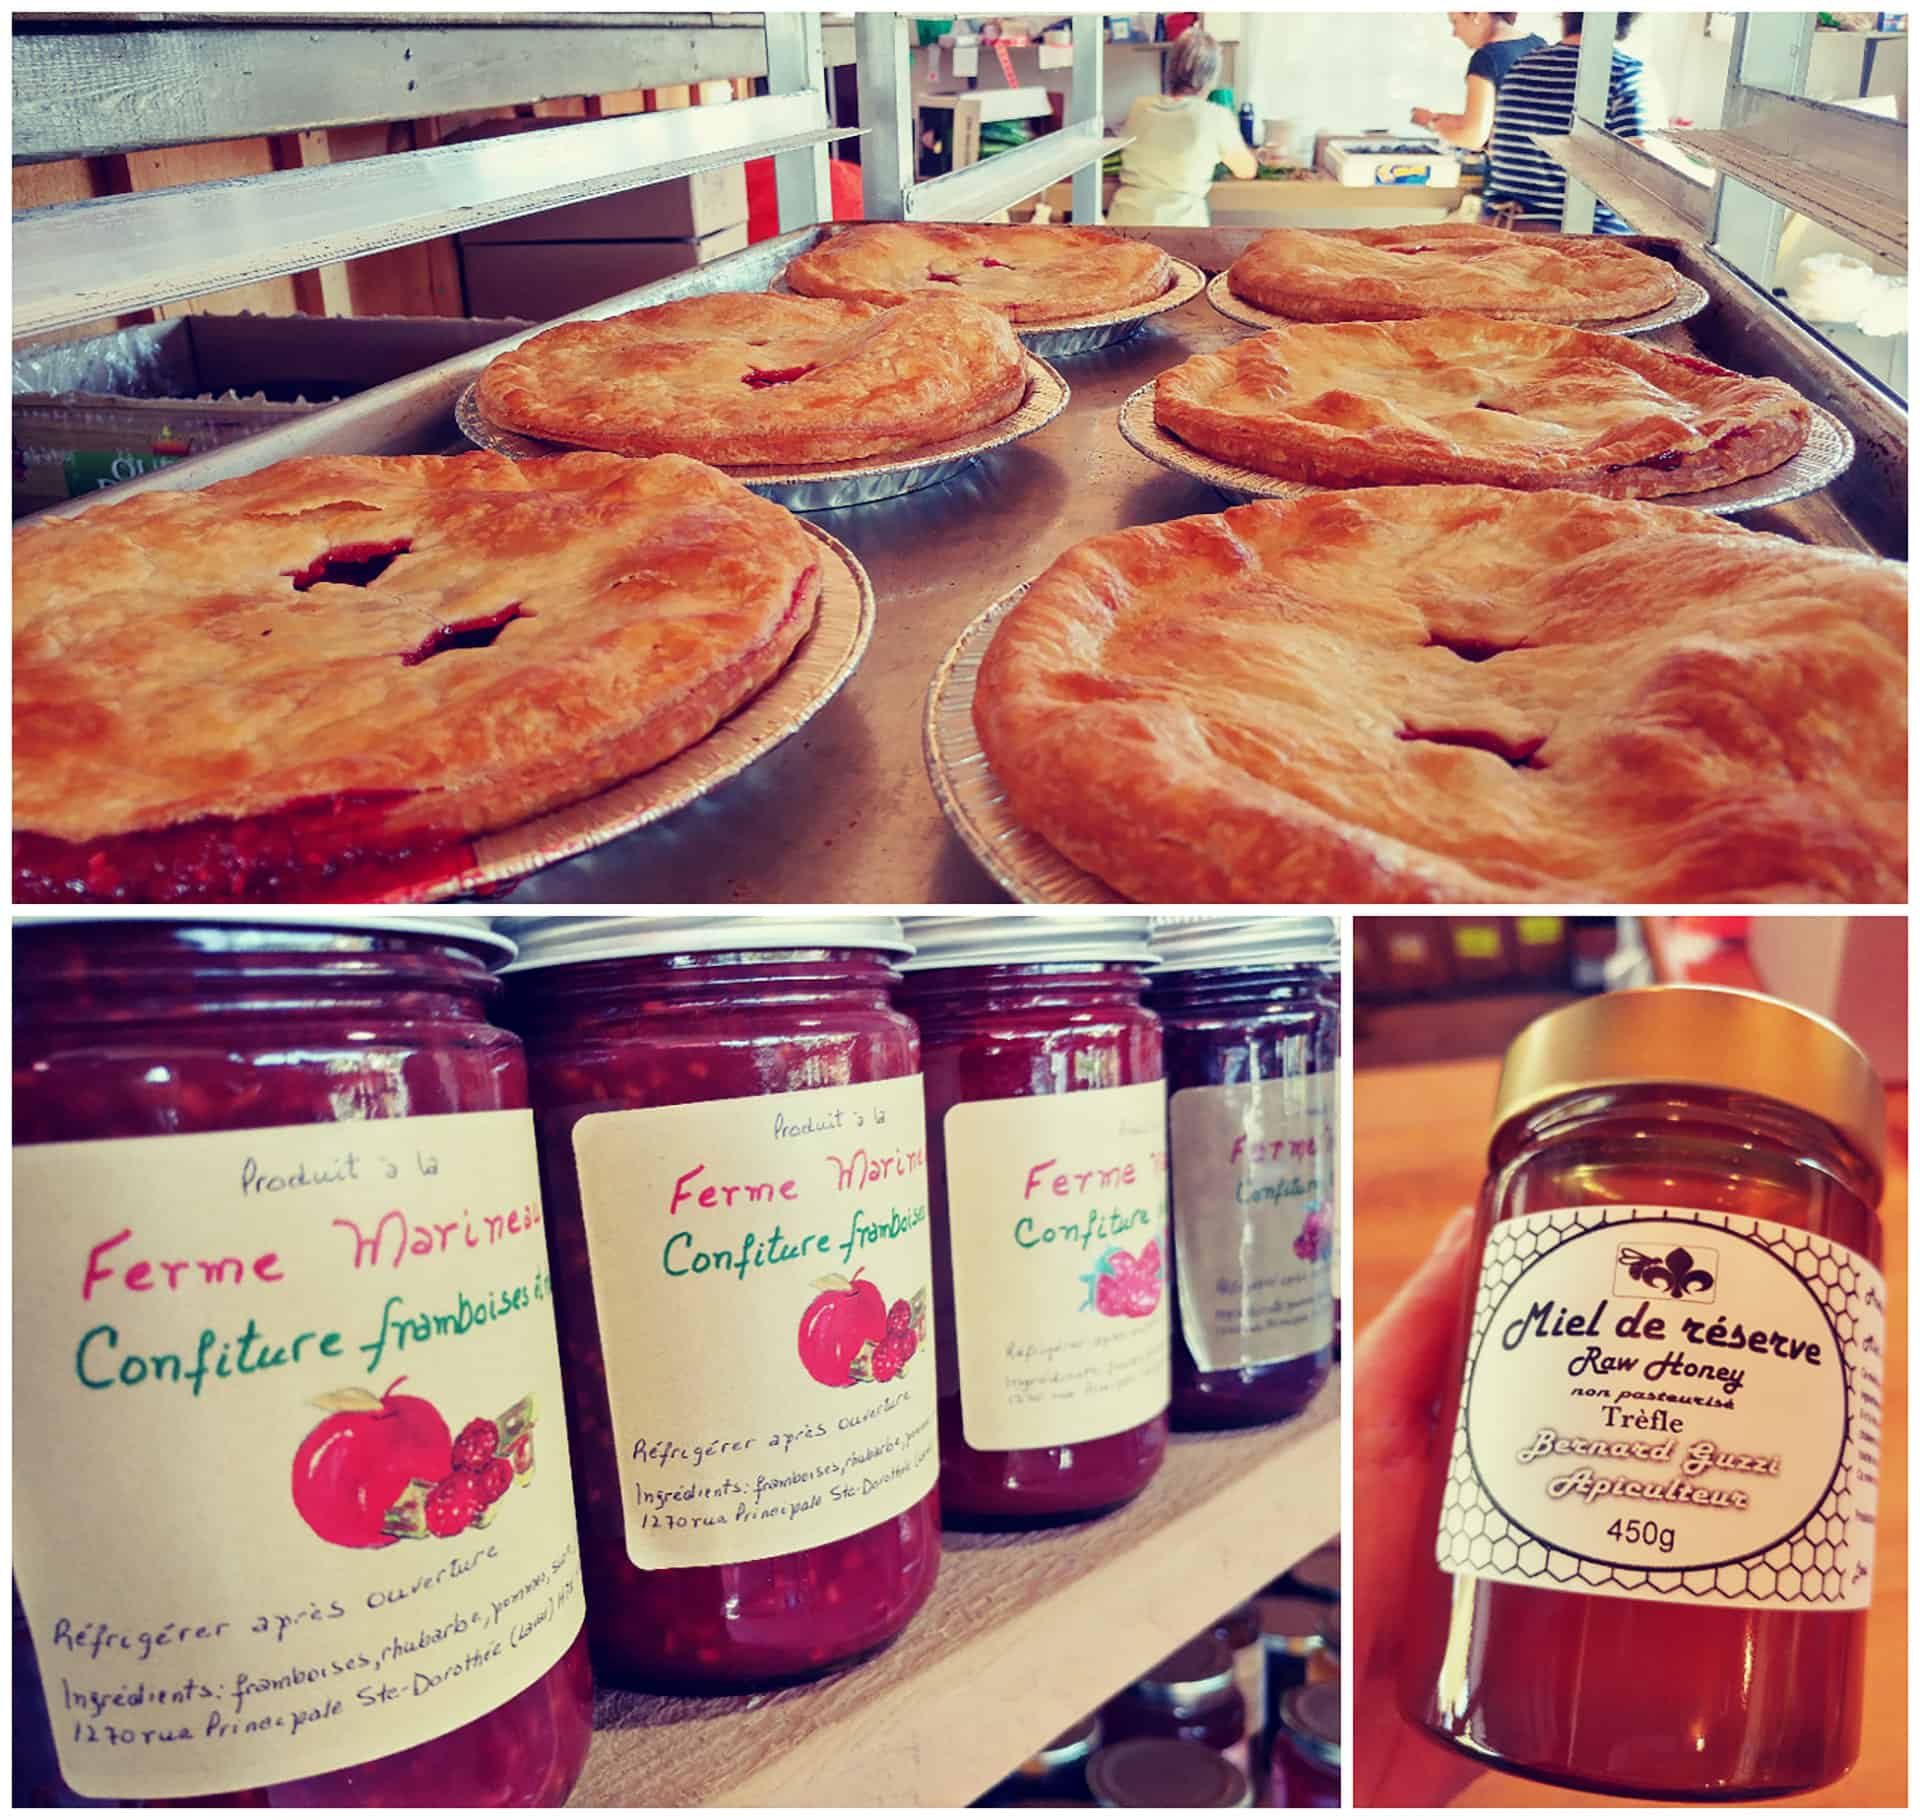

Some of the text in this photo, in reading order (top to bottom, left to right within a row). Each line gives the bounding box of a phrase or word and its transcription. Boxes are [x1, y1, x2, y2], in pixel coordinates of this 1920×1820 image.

[774, 1108, 844, 1140] Produit
[241, 1151, 360, 1197] Produit
[416, 1149, 439, 1176] la
[670, 1163, 800, 1215] Ferme
[1023, 1158, 1137, 1200] Ferme
[81, 1227, 285, 1301] Ferme
[662, 1224, 832, 1281] Confiture
[76, 1317, 344, 1398] Confiture
[359, 1284, 530, 1374] framboises
[1501, 1299, 1823, 1366] Miel de réserve
[1567, 1346, 1746, 1394] Raw Honey
[1570, 1385, 1736, 1411] non pasteurisé
[1602, 1404, 1684, 1433] Trèfle
[632, 1437, 758, 1468] Réfrigérer
[768, 1423, 828, 1454] après
[1516, 1427, 1784, 1479] Bernard Guzzi
[1547, 1465, 1750, 1511] Apiculteur
[1606, 1517, 1677, 1554] 450g
[52, 1616, 231, 1660] Réfrigérer
[251, 1600, 345, 1643] après
[73, 1719, 135, 1746] 1270
